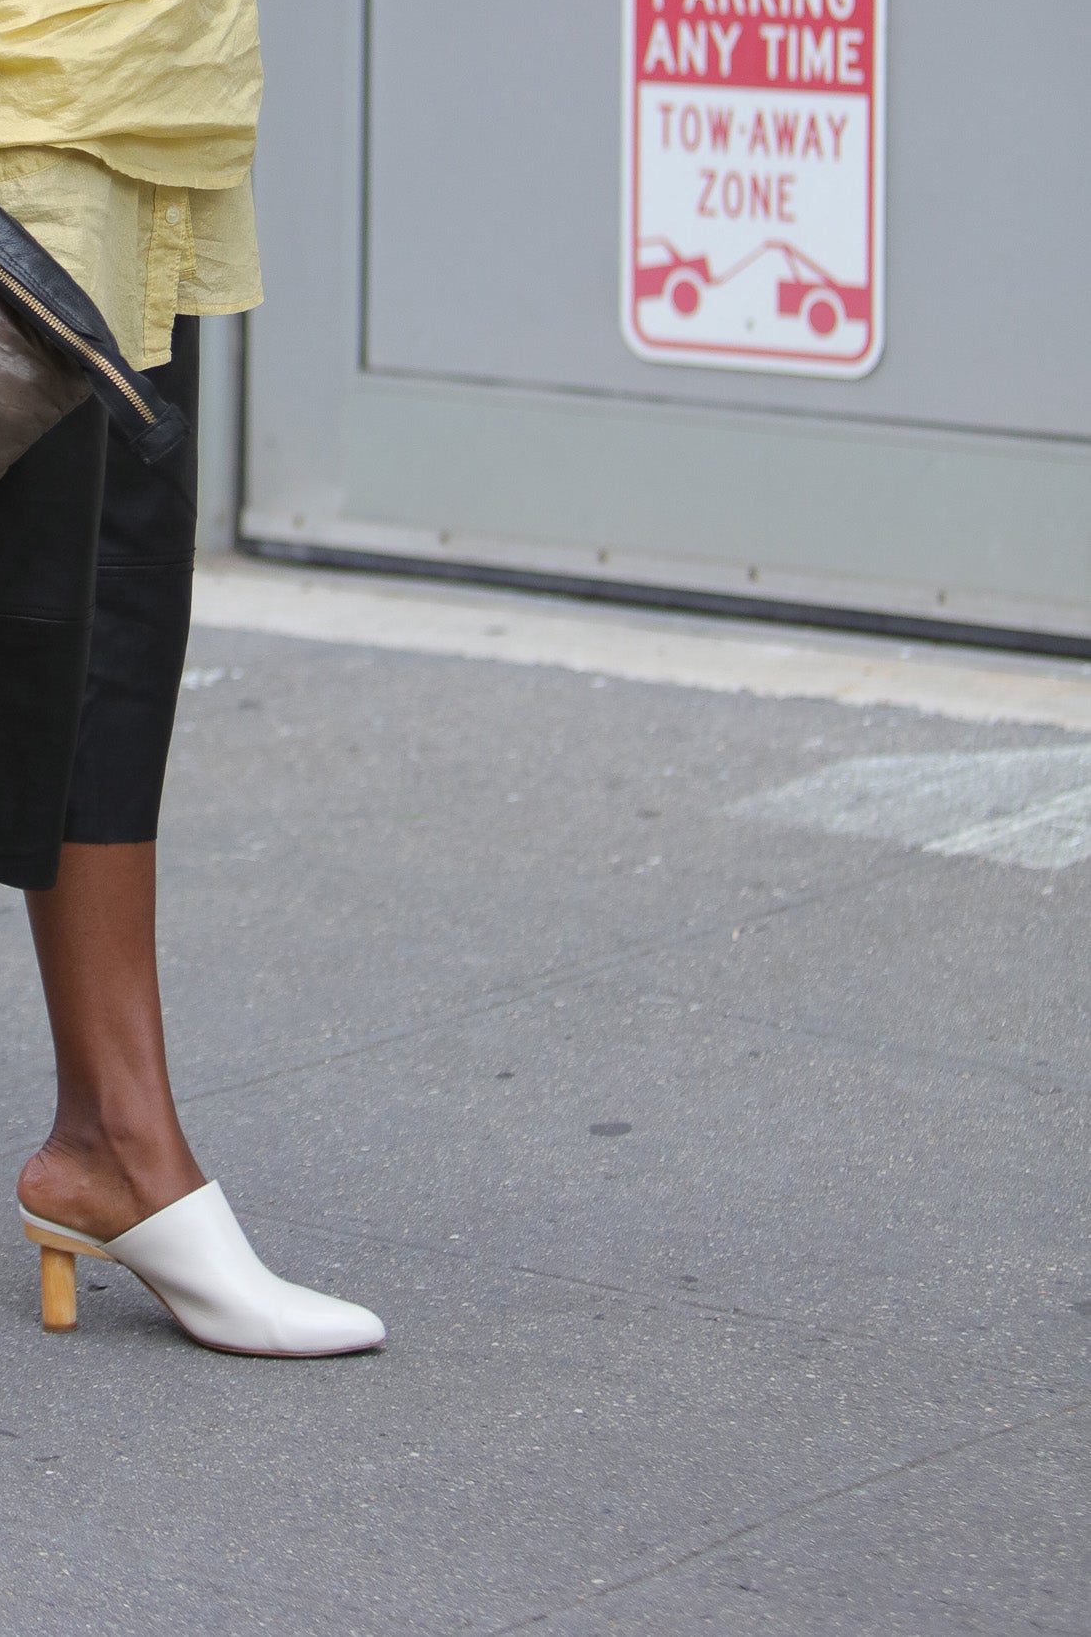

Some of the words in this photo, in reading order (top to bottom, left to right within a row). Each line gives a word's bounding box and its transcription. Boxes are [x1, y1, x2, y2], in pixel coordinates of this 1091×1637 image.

[643, 19, 743, 79] ANY
[759, 25, 865, 86] TIME
[697, 170, 797, 223] ZONE
